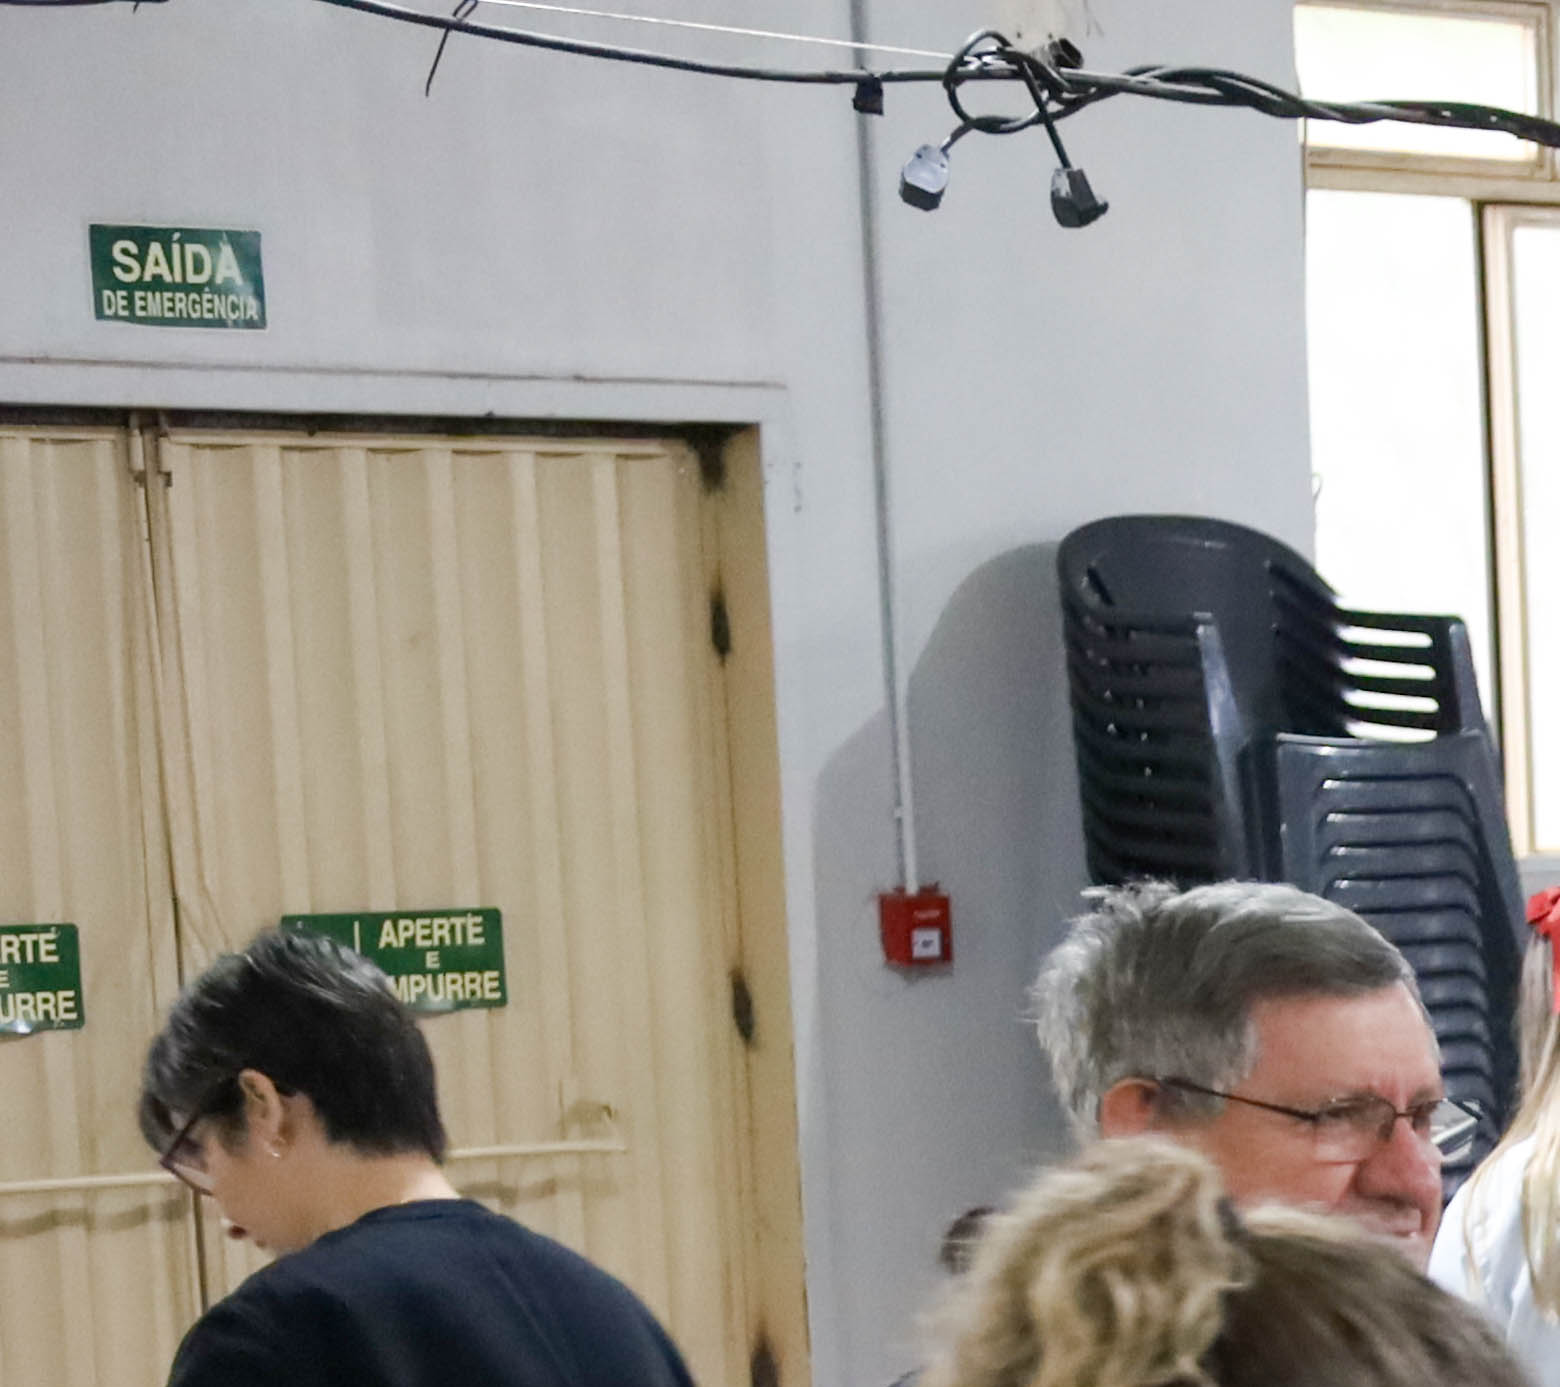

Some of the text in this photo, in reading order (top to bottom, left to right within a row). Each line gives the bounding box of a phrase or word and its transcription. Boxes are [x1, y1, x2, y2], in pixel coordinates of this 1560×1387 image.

[112, 232, 244, 285] SAÍDA
[102, 287, 260, 321] DE EMERGÊNCIA
[0, 931, 60, 964] RTE
[378, 914, 486, 950] APERTE
[425, 951, 441, 969] E
[386, 970, 502, 1004] MPURRE
[0, 990, 78, 1024] URRE
